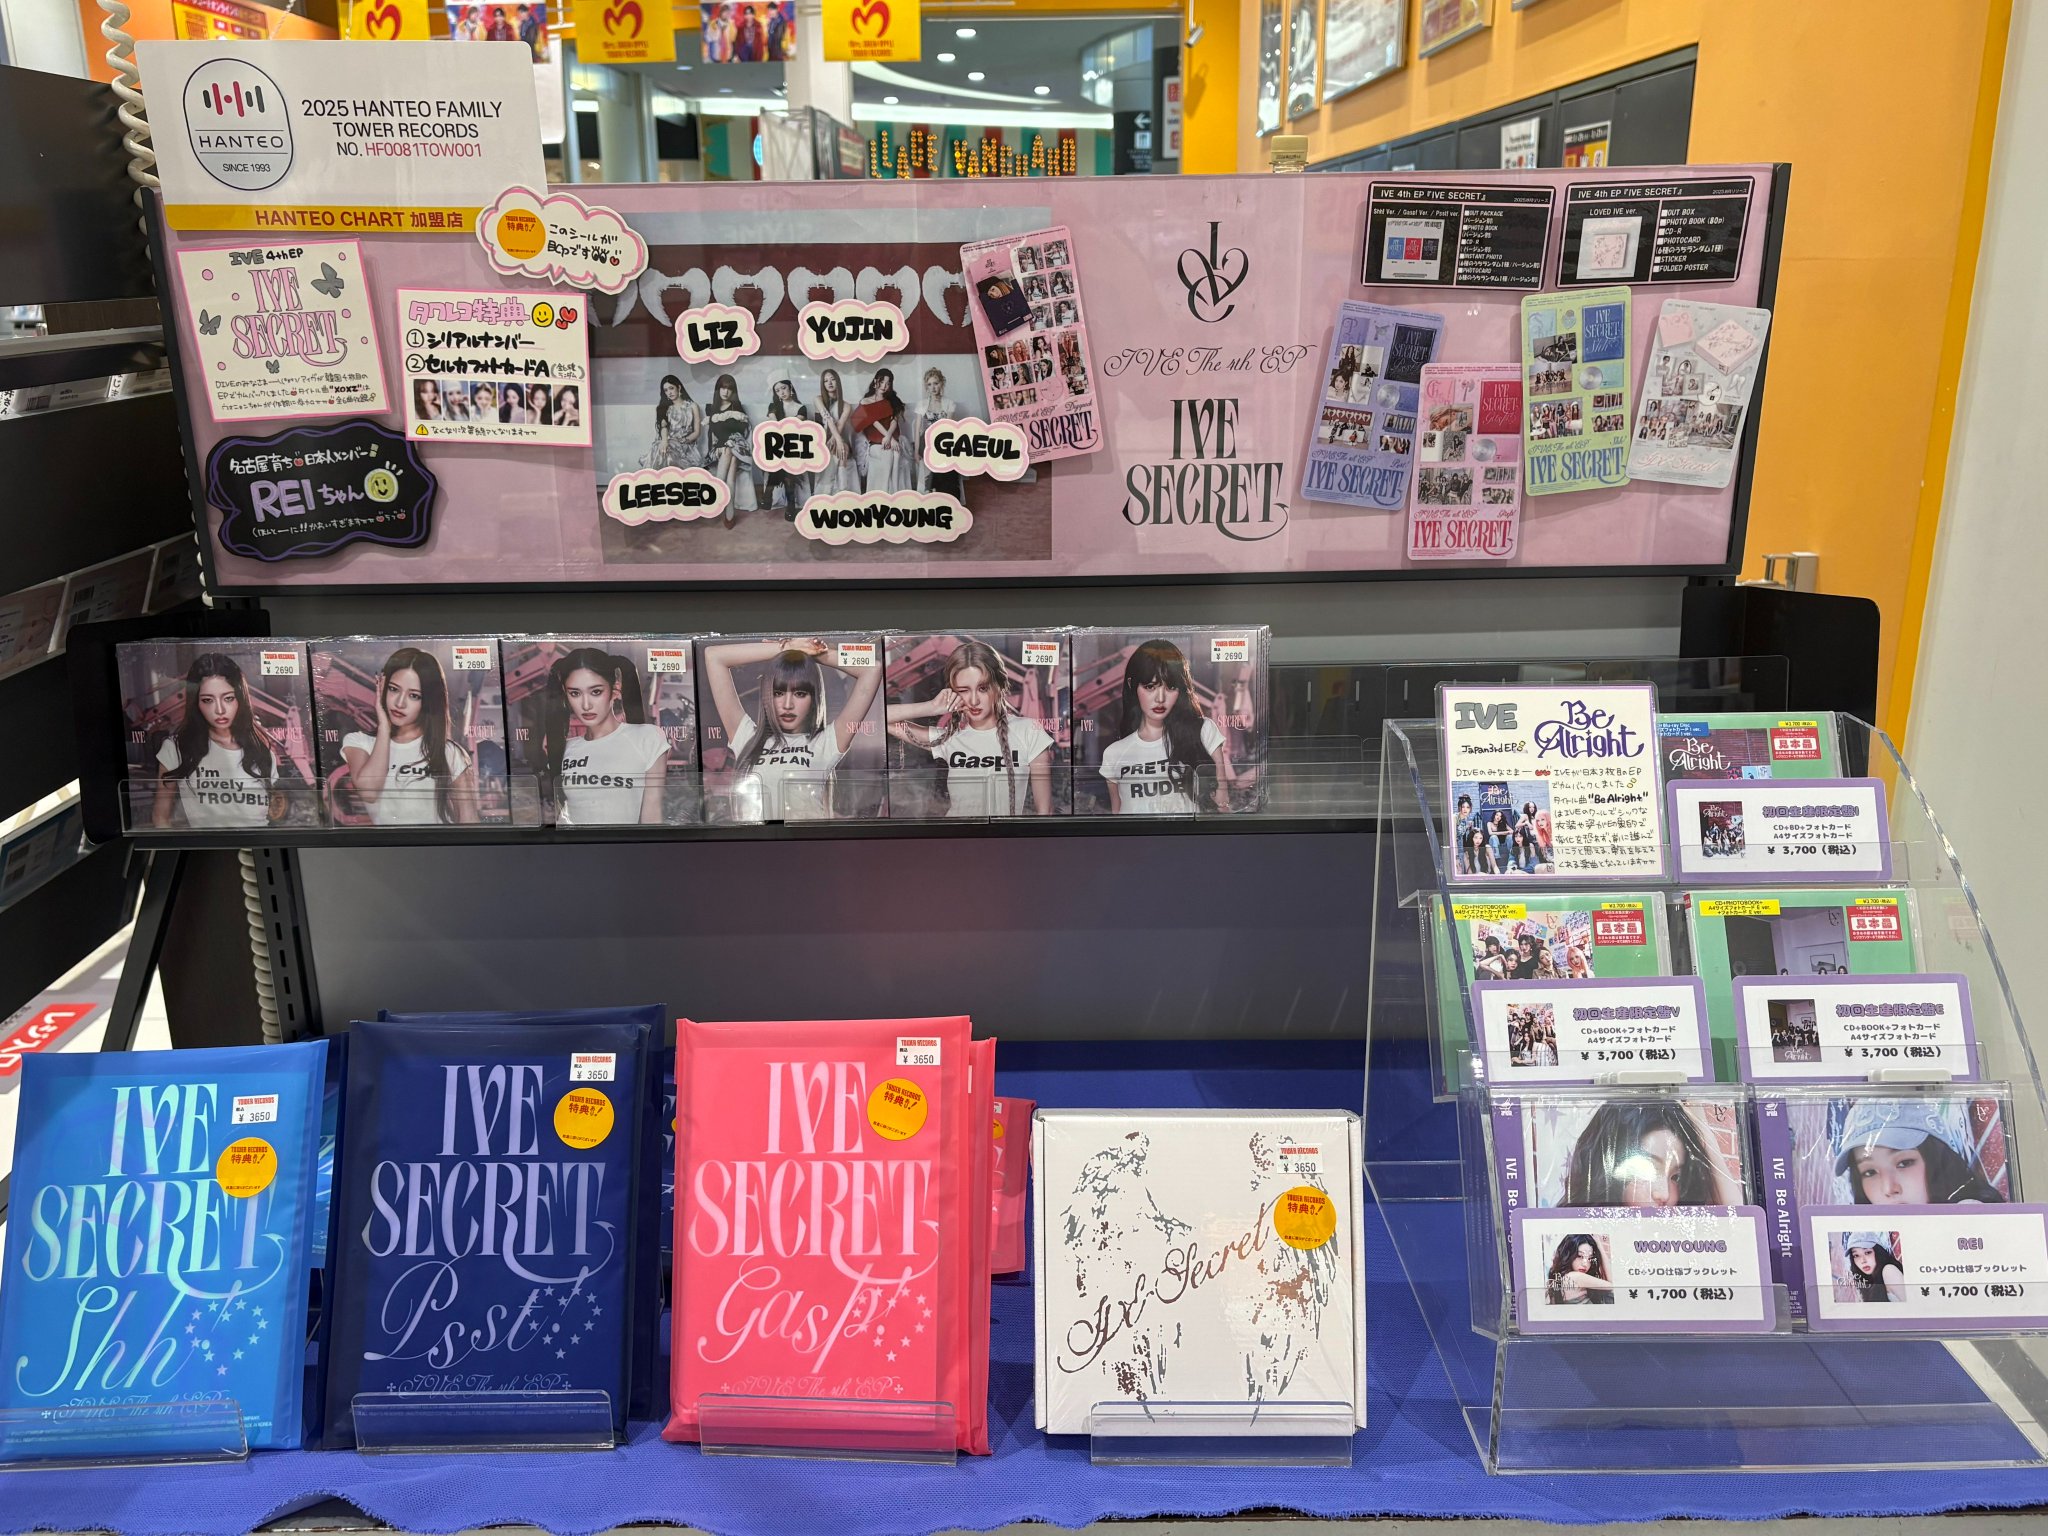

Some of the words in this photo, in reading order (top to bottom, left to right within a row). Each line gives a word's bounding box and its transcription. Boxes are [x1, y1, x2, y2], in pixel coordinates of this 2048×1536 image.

[301, 99, 348, 117] 2025
[353, 99, 432, 118] HANTEO
[436, 101, 503, 119] FAMILY
[332, 122, 396, 138] TOWER
[398, 123, 479, 139] RECORDS
[199, 135, 284, 150] HANTEO
[336, 142, 363, 157] NO.
[365, 143, 482, 157] HF0081TOW001
[222, 163, 249, 173] SINCE
[250, 163, 271, 173] 1993
[1381, 190, 1394, 198] IVE
[1397, 190, 1411, 199] 4th
[1413, 191, 1425, 199] EP
[1578, 190, 1592, 198] IVE
[1595, 190, 1608, 198] 4th
[1610, 189, 1621, 197] EP
[255, 209, 335, 227] HANTEO
[340, 211, 404, 228] CHART
[409, 211, 464, 229] 加盟店
[1590, 208, 1611, 216] LOVED
[1682, 208, 1695, 216] BOX
[549, 223, 618, 245] このシールが
[229, 249, 265, 266] IVE
[248, 267, 303, 313] IVE
[409, 296, 530, 327] タワレコ特典
[687, 320, 743, 353] LIZ
[806, 315, 893, 344] YUJIN
[230, 310, 348, 367] SECRET
[1103, 347, 1184, 377] IVE
[1186, 346, 1223, 375] The
[1259, 345, 1317, 376] EP
[1029, 410, 1099, 449] SECRET
[1169, 398, 1239, 461] IVE
[764, 431, 814, 461] REI
[933, 431, 1020, 460] GAEUL
[229, 453, 293, 475] 名古屋育ち
[304, 446, 369, 466] 日本人メンバー
[1529, 454, 1557, 485] IVE
[1560, 446, 1627, 485] SECRET
[1306, 459, 1338, 490] IVE
[1338, 463, 1404, 506] SECRET
[250, 478, 316, 523] REI
[317, 484, 365, 506] ちゃん
[619, 481, 717, 511] LEESEO
[1122, 462, 1289, 542] SECRET
[810, 503, 953, 530] WONYOUNG
[1413, 520, 1442, 548] IVE
[1445, 519, 1514, 556] SECRET
[467, 660, 485, 668] 2690
[852, 657, 869, 665] 2690
[1035, 655, 1053, 663] 2690
[1224, 652, 1243, 660] 2690
[275, 666, 293, 674] 2690
[661, 662, 680, 671] 2690
[1217, 714, 1249, 730] SECRET
[1454, 702, 1517, 730] IVE
[1560, 700, 1615, 730] Be
[708, 726, 722, 740] IVE
[846, 722, 877, 737] SECRET
[1080, 719, 1094, 732] IVE
[131, 729, 146, 744] IVE
[325, 729, 338, 742] IVE
[515, 728, 529, 741] IVE
[1533, 720, 1645, 759] Alright
[1682, 737, 1714, 755] Be
[1778, 739, 1813, 750] 見本品
[562, 755, 588, 772] Bad
[769, 756, 810, 768] PLAN
[949, 750, 1019, 772] Gasp!
[1669, 749, 1731, 771] Alright
[196, 777, 244, 791] lovely
[1773, 823, 1852, 831] CD+BD+フォトカード
[1767, 846, 1775, 855] ¥
[1783, 846, 1817, 855] 3,700
[1601, 923, 1638, 933] 見本品
[1856, 918, 1893, 929] 見本品
[1580, 1025, 1677, 1035] CD+BOOK+フォトカード
[1844, 1023, 1941, 1032] CD+BOOK+フォトカード
[1587, 1035, 1672, 1044] A4サイズフォトカード
[1850, 1032, 1937, 1041] A4サイズフォトカード
[903, 1055, 908, 1064] ¥
[913, 1055, 934, 1064] 3650
[1580, 1051, 1590, 1061] ¥
[1597, 1050, 1634, 1061] 3,700
[1844, 1048, 1853, 1057] ¥
[1861, 1047, 1898, 1058] 3,700
[577, 1071, 582, 1079] ¥
[587, 1070, 608, 1080] 3650
[436, 1064, 544, 1156] IVE
[763, 1061, 868, 1154] IVE
[239, 1113, 244, 1122] ¥
[250, 1111, 271, 1122] 3650
[102, 1083, 218, 1178] IVE
[1283, 1163, 1289, 1173] ¥
[1294, 1162, 1317, 1173] 3650
[1505, 1157, 1518, 1180] IVE
[1772, 1157, 1785, 1180] IVE
[1507, 1189, 1518, 1207] Be
[1775, 1189, 1787, 1207] Be
[361, 1161, 616, 1284] SECRET
[688, 1159, 940, 1285] SECRET
[21, 1179, 287, 1300] SECRET
[1777, 1208, 1793, 1258] Alright
[1634, 1240, 1728, 1253] WONYOUNG
[1957, 1237, 1984, 1251] REI
[1919, 1263, 2028, 1274] CD+ソロ仕様ブックレット
[1629, 1289, 1639, 1299] ¥
[1646, 1288, 1688, 1301] 1,700
[1920, 1286, 1931, 1297] ¥
[1939, 1286, 1979, 1298] 1,700
[697, 1254, 914, 1375] Gasp!
